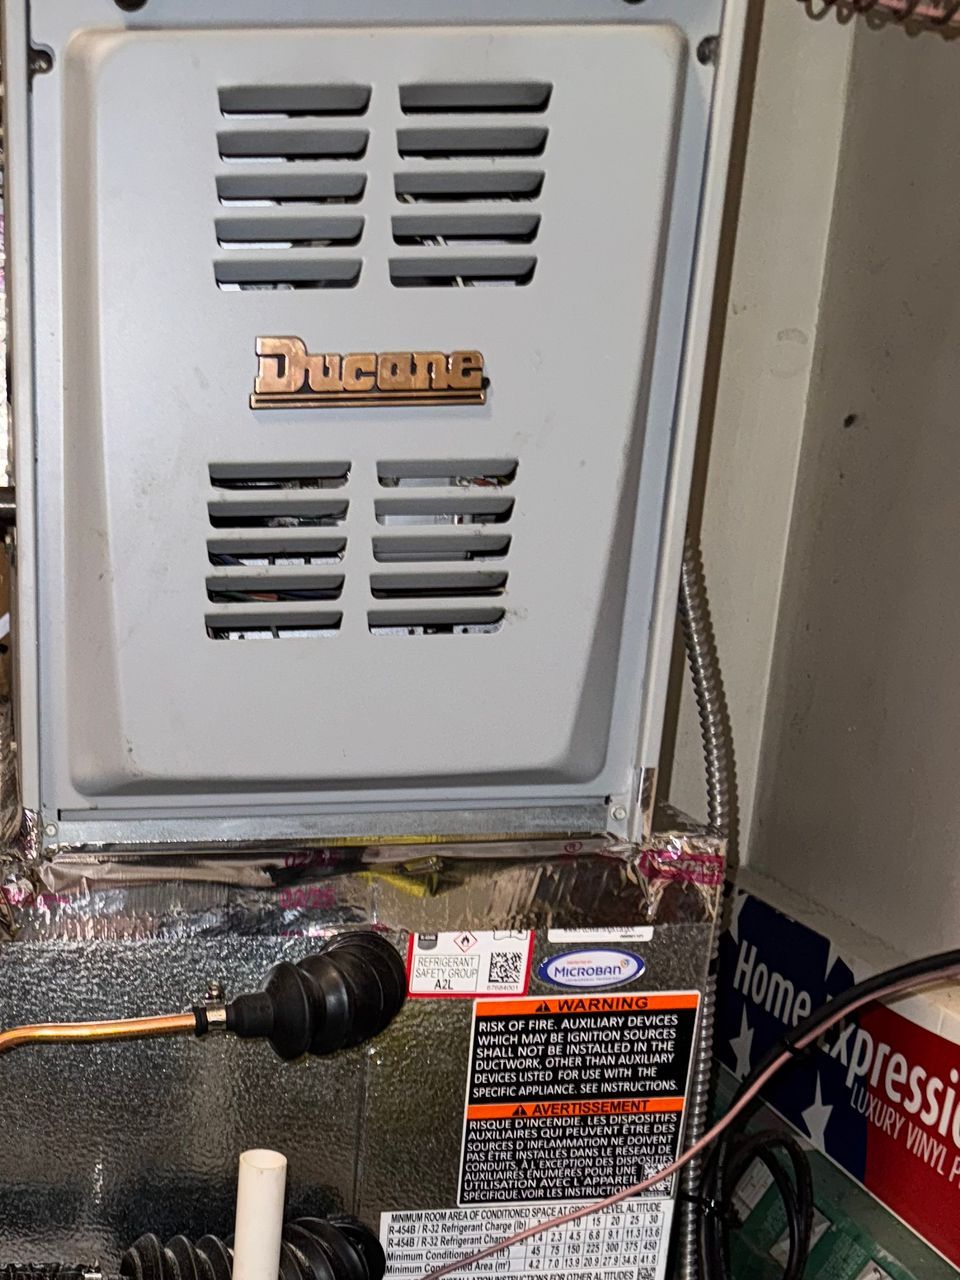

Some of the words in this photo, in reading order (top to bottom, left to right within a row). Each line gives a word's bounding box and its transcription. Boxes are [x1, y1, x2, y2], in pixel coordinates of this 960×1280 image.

[254, 336, 484, 393] Ducane
[418, 957, 475, 967] REFRIGERANT
[415, 967, 446, 979] SAFETY
[447, 966, 478, 979] GROUP
[554, 965, 622, 978] MICROBAN
[434, 979, 454, 990] A2L
[733, 940, 812, 1027] Home
[557, 996, 649, 1012] WARNING
[478, 1020, 506, 1033] RISK
[507, 1019, 526, 1032] OF
[528, 1018, 558, 1031] FIRE.
[560, 1015, 624, 1029] AUXILIARY
[627, 1013, 679, 1027] DEVICES
[477, 1033, 518, 1046] WHICH
[520, 1032, 547, 1044] MAY
[549, 1032, 564, 1043] BE
[567, 1029, 621, 1043] IGNITION
[622, 1027, 677, 1040] SOURCES
[475, 1046, 514, 1058] SHALL
[517, 1045, 544, 1056] NOT
[547, 1044, 562, 1055] BE
[566, 1041, 630, 1055] INSTALLED
[633, 1041, 647, 1052] IN
[649, 1040, 675, 1051] THE
[475, 1057, 543, 1071] DUCTWORK,
[544, 1056, 582, 1068] OTHER
[584, 1054, 615, 1066] THAN
[617, 1052, 675, 1065] AUXILIARY
[474, 1071, 517, 1083] DEVICES
[519, 1070, 553, 1082] LISTED
[558, 1069, 579, 1080] FOR
[581, 1068, 601, 1079] USE
[603, 1067, 632, 1079] WITH
[637, 1066, 657, 1077] THE
[472, 1085, 516, 1098] SPECIFIC
[518, 1083, 578, 1096] APPLIANCE.
[579, 1082, 598, 1094] SEE
[600, 1079, 679, 1093] INSTRUCTIONS.
[531, 1099, 649, 1115] AVERTISSEMENT
[468, 1118, 512, 1130] RISQUE
[586, 1115, 607, 1125] LES
[609, 1112, 677, 1125] DISPOSITIFS
[850, 1082, 906, 1140] LUXURY
[906, 1121, 947, 1176] VINYL
[468, 1128, 538, 1140] AUXILIAIRES
[540, 1127, 562, 1137] QUI
[565, 1125, 619, 1137] PEUVENT
[622, 1124, 650, 1134] ÊTRE
[652, 1123, 675, 1133] DES
[466, 1140, 513, 1151] SOURCES
[515, 1137, 608, 1150] D'INFLAMMATION
[610, 1136, 624, 1146] NE
[626, 1134, 672, 1146] DOIVENT
[466, 1151, 485, 1161] PAS
[487, 1150, 513, 1160] ÊTRE
[569, 1147, 599, 1157] DANS
[601, 1147, 613, 1156] LE
[616, 1145, 655, 1156] RÉSEAU
[657, 1145, 672, 1154] DE
[464, 1160, 518, 1171] CONDUITS,
[594, 1157, 614, 1166] DES
[464, 1169, 524, 1181] AUXILIAIRES
[584, 1166, 612, 1176] POUR
[615, 1165, 636, 1175] UNE
[464, 1178, 536, 1190] UTILISATION
[539, 1177, 572, 1187] AVEC
[546, 1188, 561, 1197] LES
[563, 1185, 630, 1197] INSTRUCTION
[391, 1212, 422, 1223] MINIMUM
[423, 1211, 447, 1222] ROOM
[447, 1210, 468, 1221] AREA
[468, 1210, 479, 1220] OF
[480, 1208, 530, 1220] CONDITIONED
[531, 1207, 556, 1218] SPACE
[557, 1206, 568, 1216] AT
[601, 1204, 625, 1215] LEVEL
[625, 1202, 662, 1214] ALTITUDE
[388, 1224, 416, 1235] R-454B
[421, 1223, 440, 1234] R-32
[440, 1222, 483, 1233] Refrigerant
[484, 1220, 512, 1232] Charge
[513, 1220, 526, 1230] (lb)
[571, 1217, 581, 1227] 10
[591, 1216, 601, 1226] 15
[610, 1215, 620, 1225] 20
[629, 1214, 640, 1225] 25
[648, 1214, 659, 1224] 30
[387, 1237, 415, 1248] R-454B
[420, 1236, 439, 1247] R-32
[439, 1234, 482, 1246] Refrigerant
[550, 1231, 562, 1242] 2.3
[568, 1230, 581, 1241] 4.5
[588, 1230, 600, 1240] 6.8
[607, 1229, 619, 1239] 9.1
[625, 1228, 640, 1239] 11.3
[644, 1227, 660, 1238] 13.6
[386, 1250, 423, 1261] Minimum
[531, 1245, 541, 1255] 45
[550, 1244, 560, 1255] 75
[566, 1244, 580, 1254] 150
[585, 1243, 600, 1253] 225
[605, 1242, 619, 1253] 300
[623, 1241, 638, 1252] 375
[642, 1241, 657, 1251] 450
[385, 1263, 422, 1274] Minimum
[474, 1261, 493, 1271] Area
[528, 1258, 540, 1269] 4.2
[547, 1258, 559, 1268] 7.0
[564, 1257, 579, 1268] 13.9
[583, 1256, 599, 1267] 20.9
[602, 1256, 618, 1266] 27.9
[620, 1255, 637, 1266] 34.8
[639, 1254, 656, 1265] 41.8
